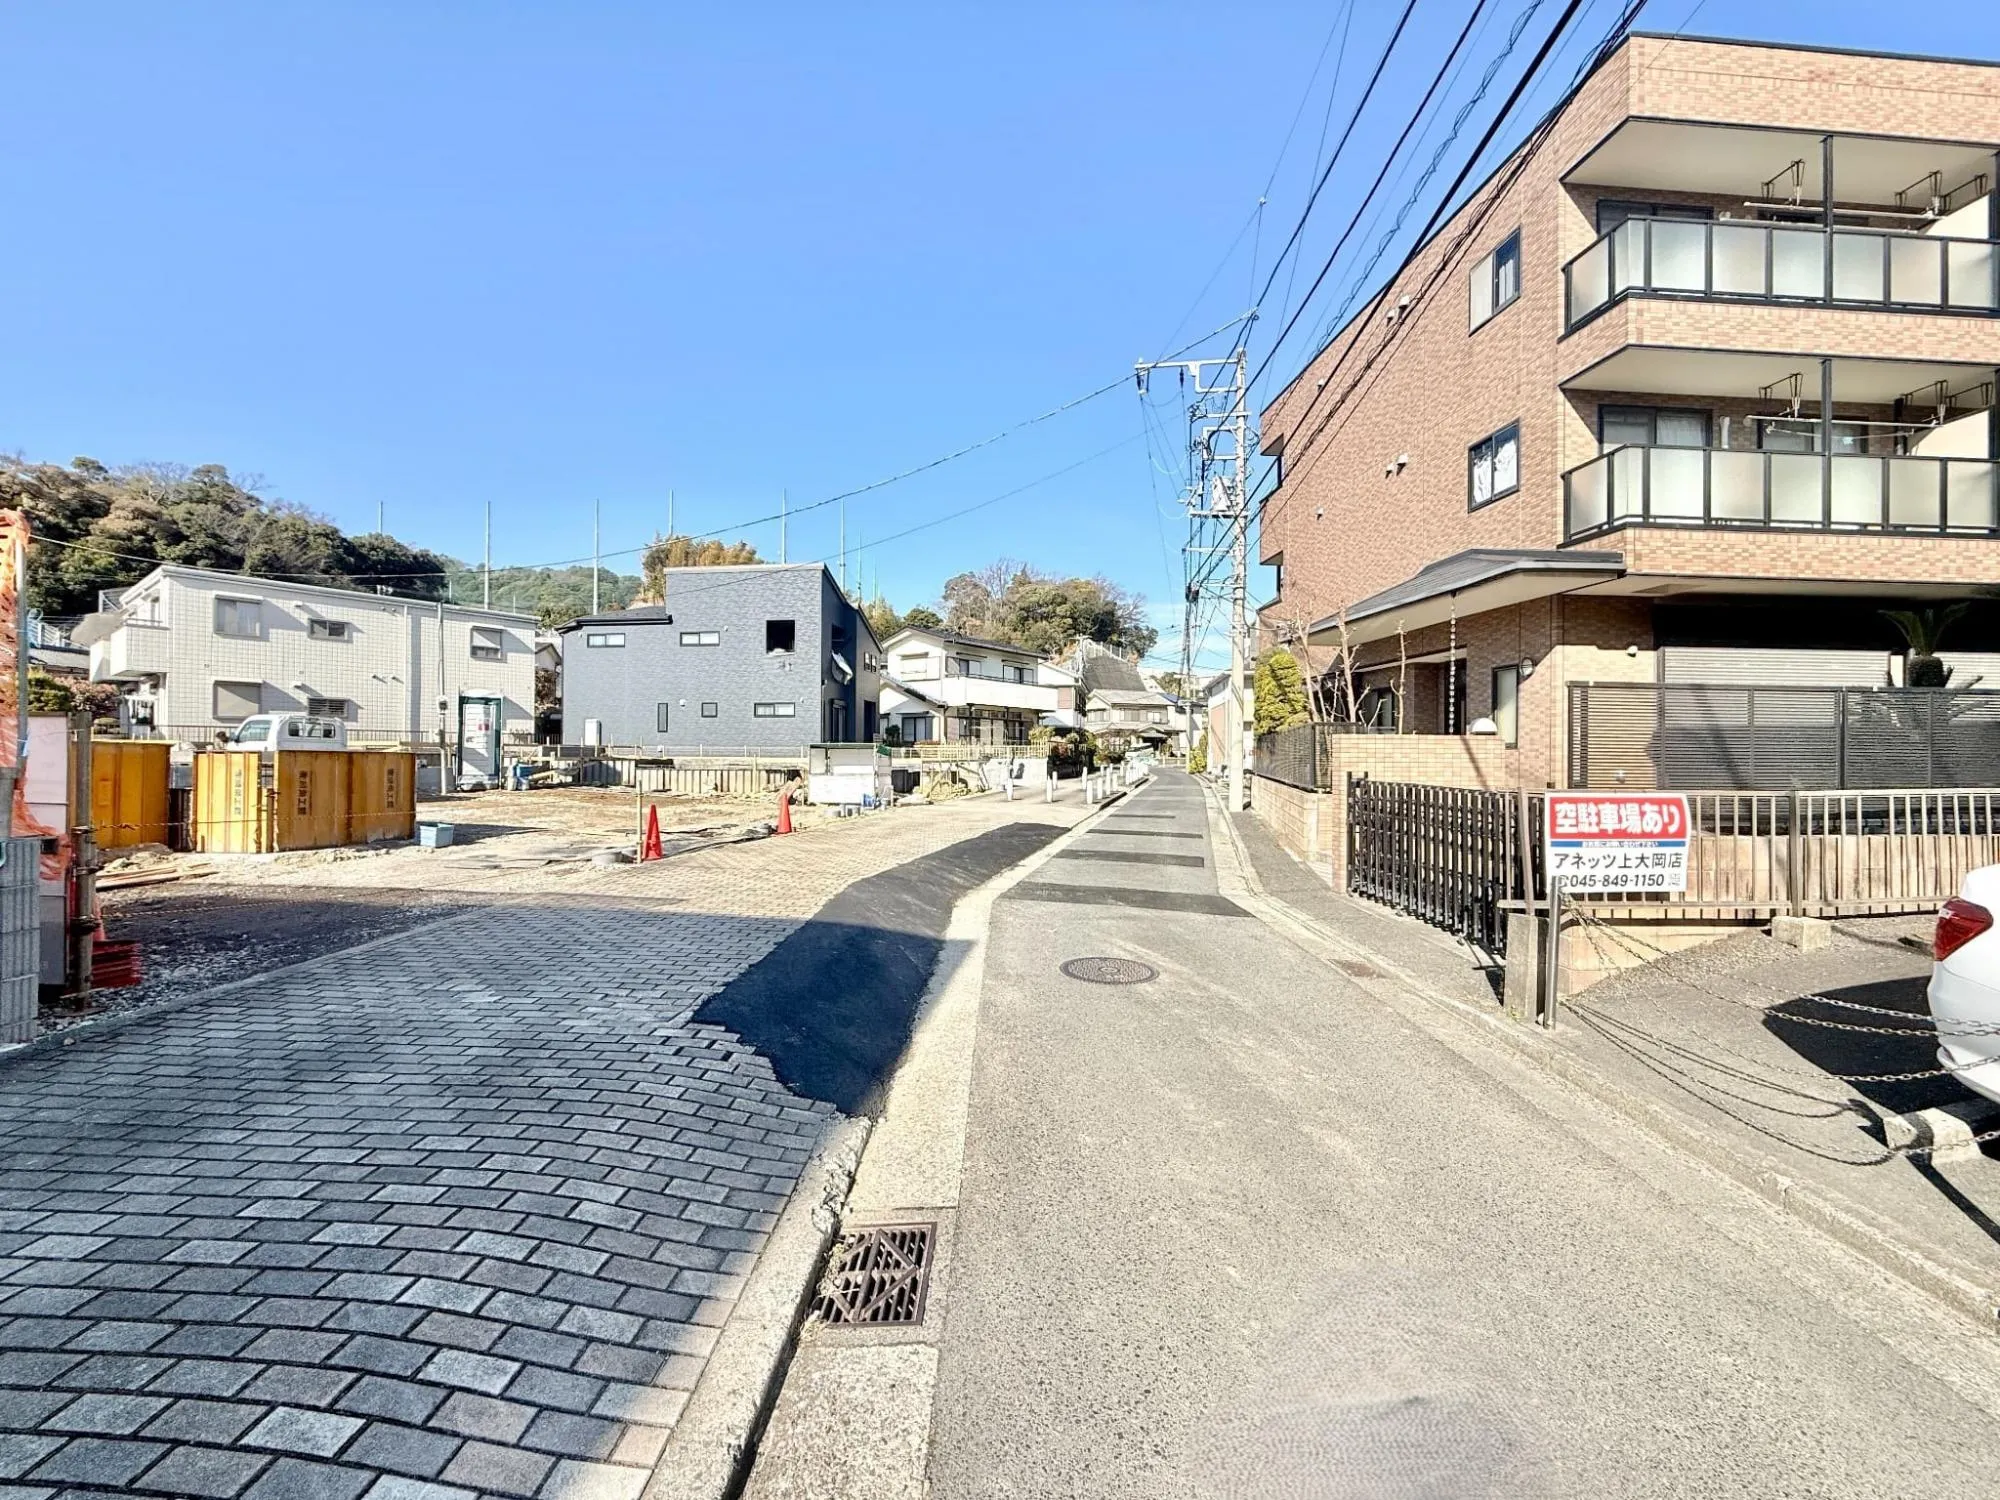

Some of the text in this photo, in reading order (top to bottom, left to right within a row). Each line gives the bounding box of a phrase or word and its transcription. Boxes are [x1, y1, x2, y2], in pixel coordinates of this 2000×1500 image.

[1555, 802, 1681, 834] 空駐車場あり
[1554, 852, 1683, 869] アネッツ上大岡店
[1570, 874, 1665, 887] 045-849-1150
